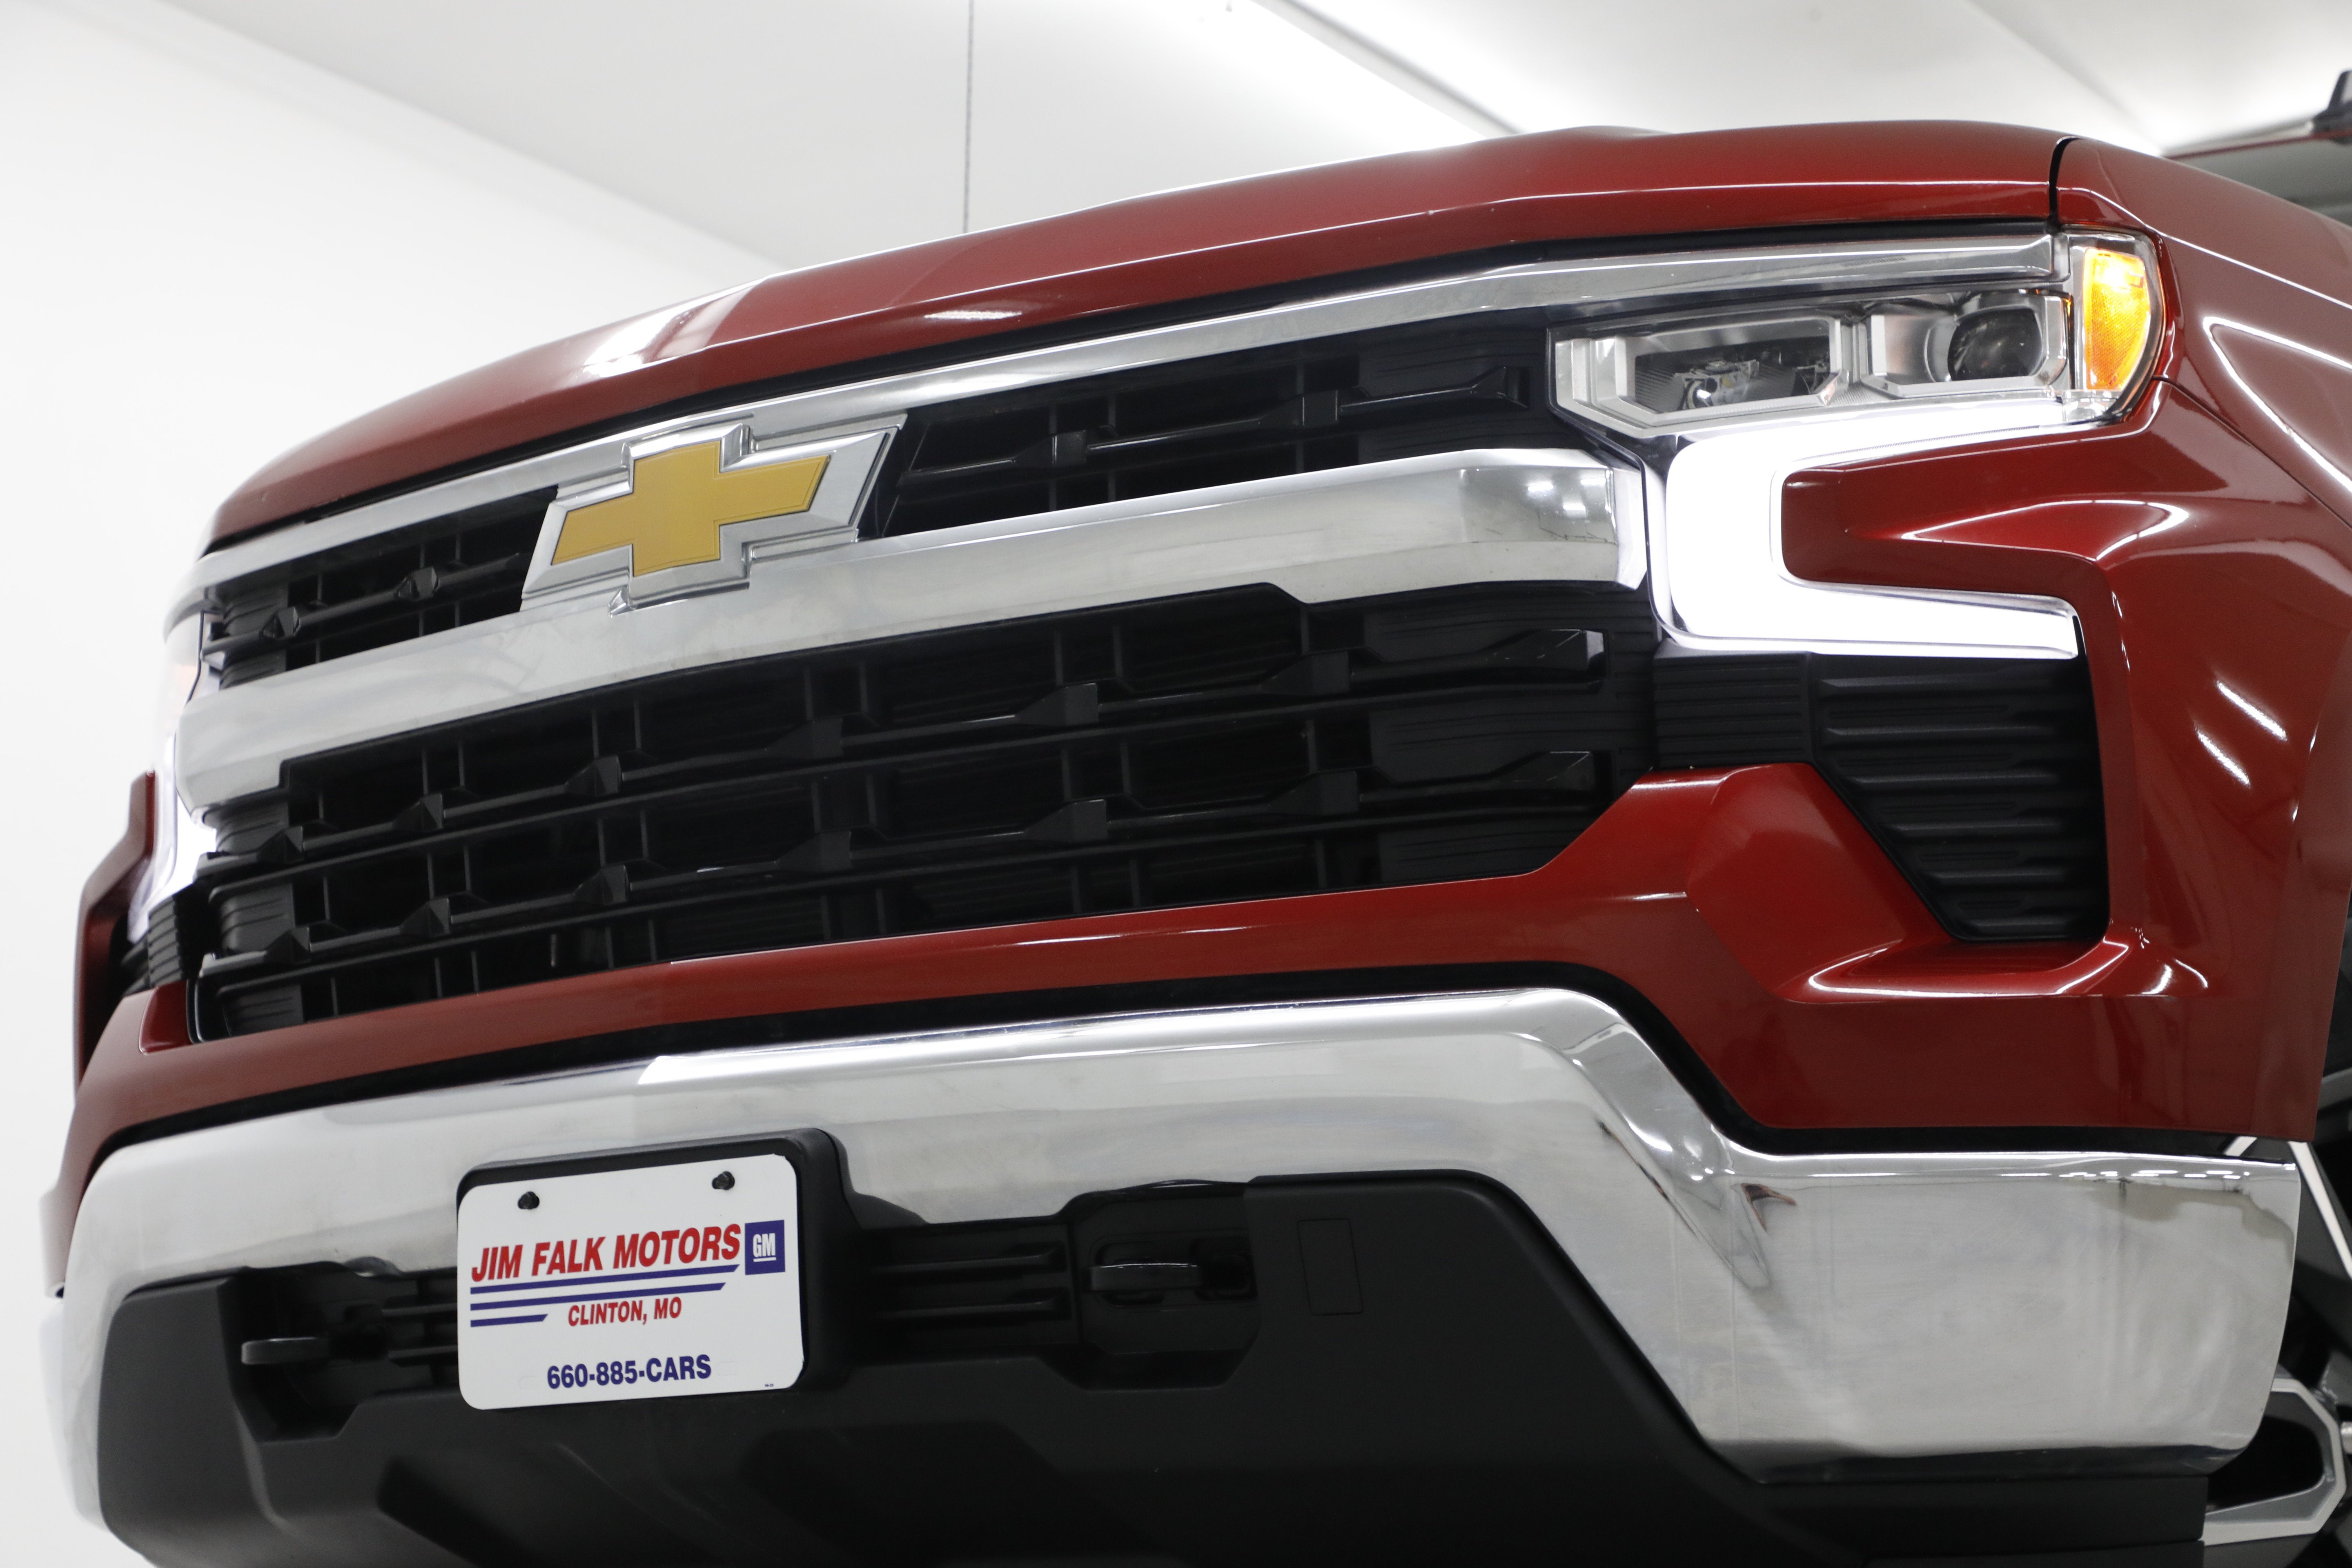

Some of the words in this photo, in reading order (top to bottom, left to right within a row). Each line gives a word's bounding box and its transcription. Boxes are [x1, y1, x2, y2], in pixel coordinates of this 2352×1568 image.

[472, 1244, 523, 1282] JIM
[532, 1236, 605, 1276] FALK
[613, 1224, 741, 1269] MOTORS
[753, 1233, 776, 1258] GM
[568, 1300, 648, 1327] CLINTON,
[654, 1296, 682, 1319] MO
[547, 1354, 711, 1389] 660-885-CARS
